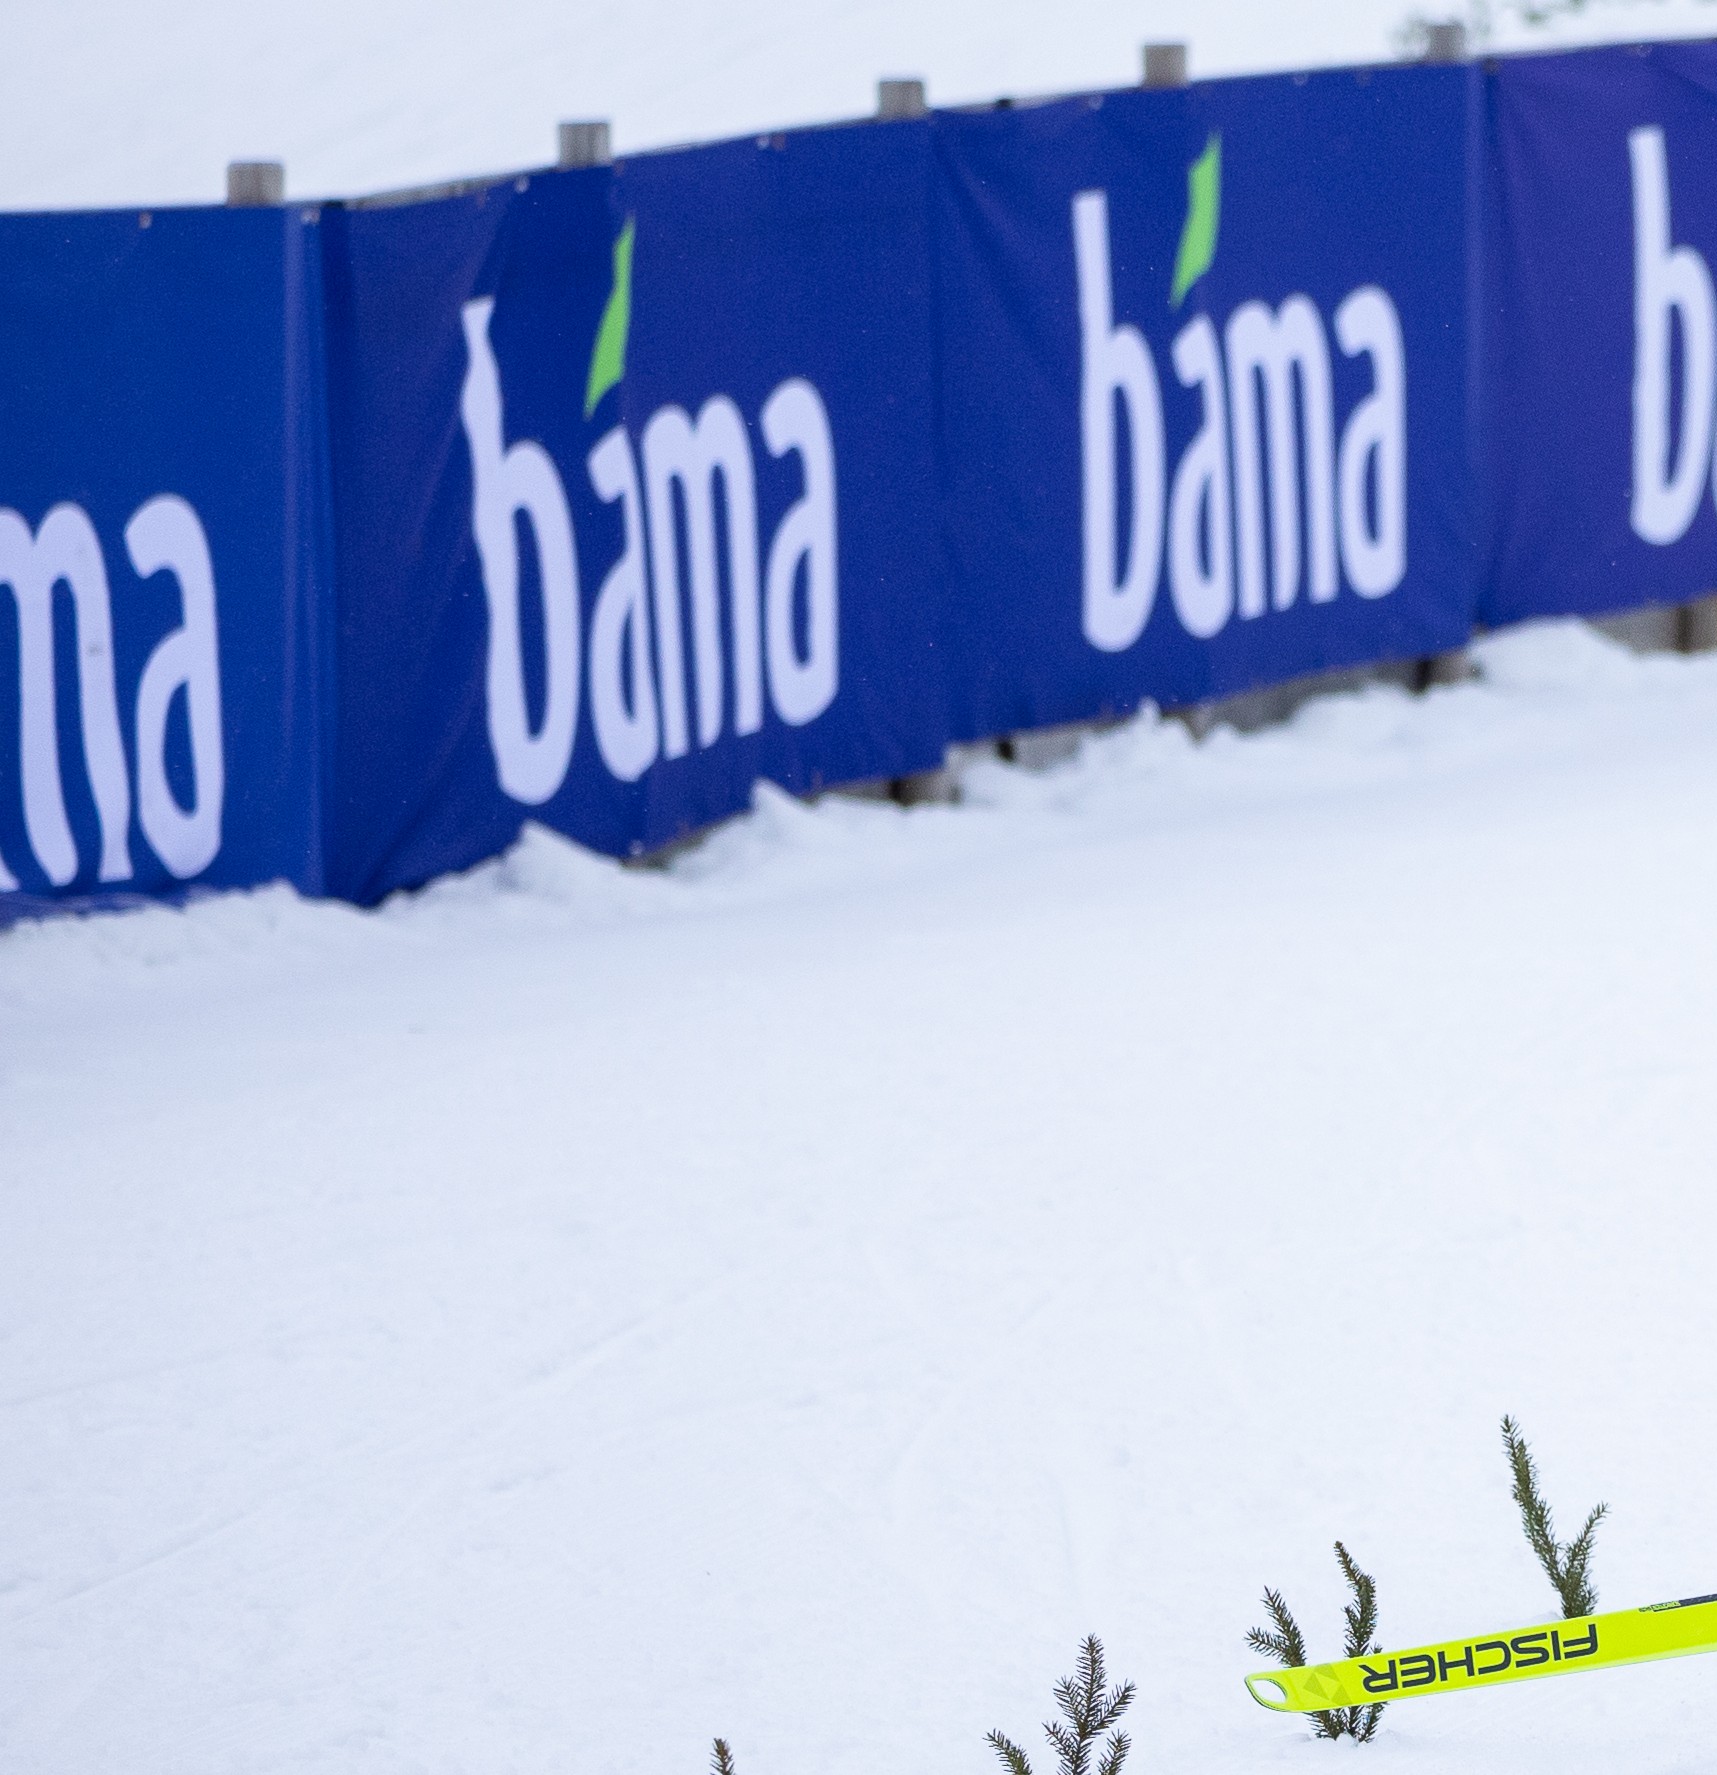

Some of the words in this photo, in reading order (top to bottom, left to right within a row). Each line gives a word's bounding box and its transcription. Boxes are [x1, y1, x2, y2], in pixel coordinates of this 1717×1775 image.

[459, 295, 839, 805] bama
[1072, 190, 1406, 652] bama
[1358, 1623, 1599, 1693] FISCHER
